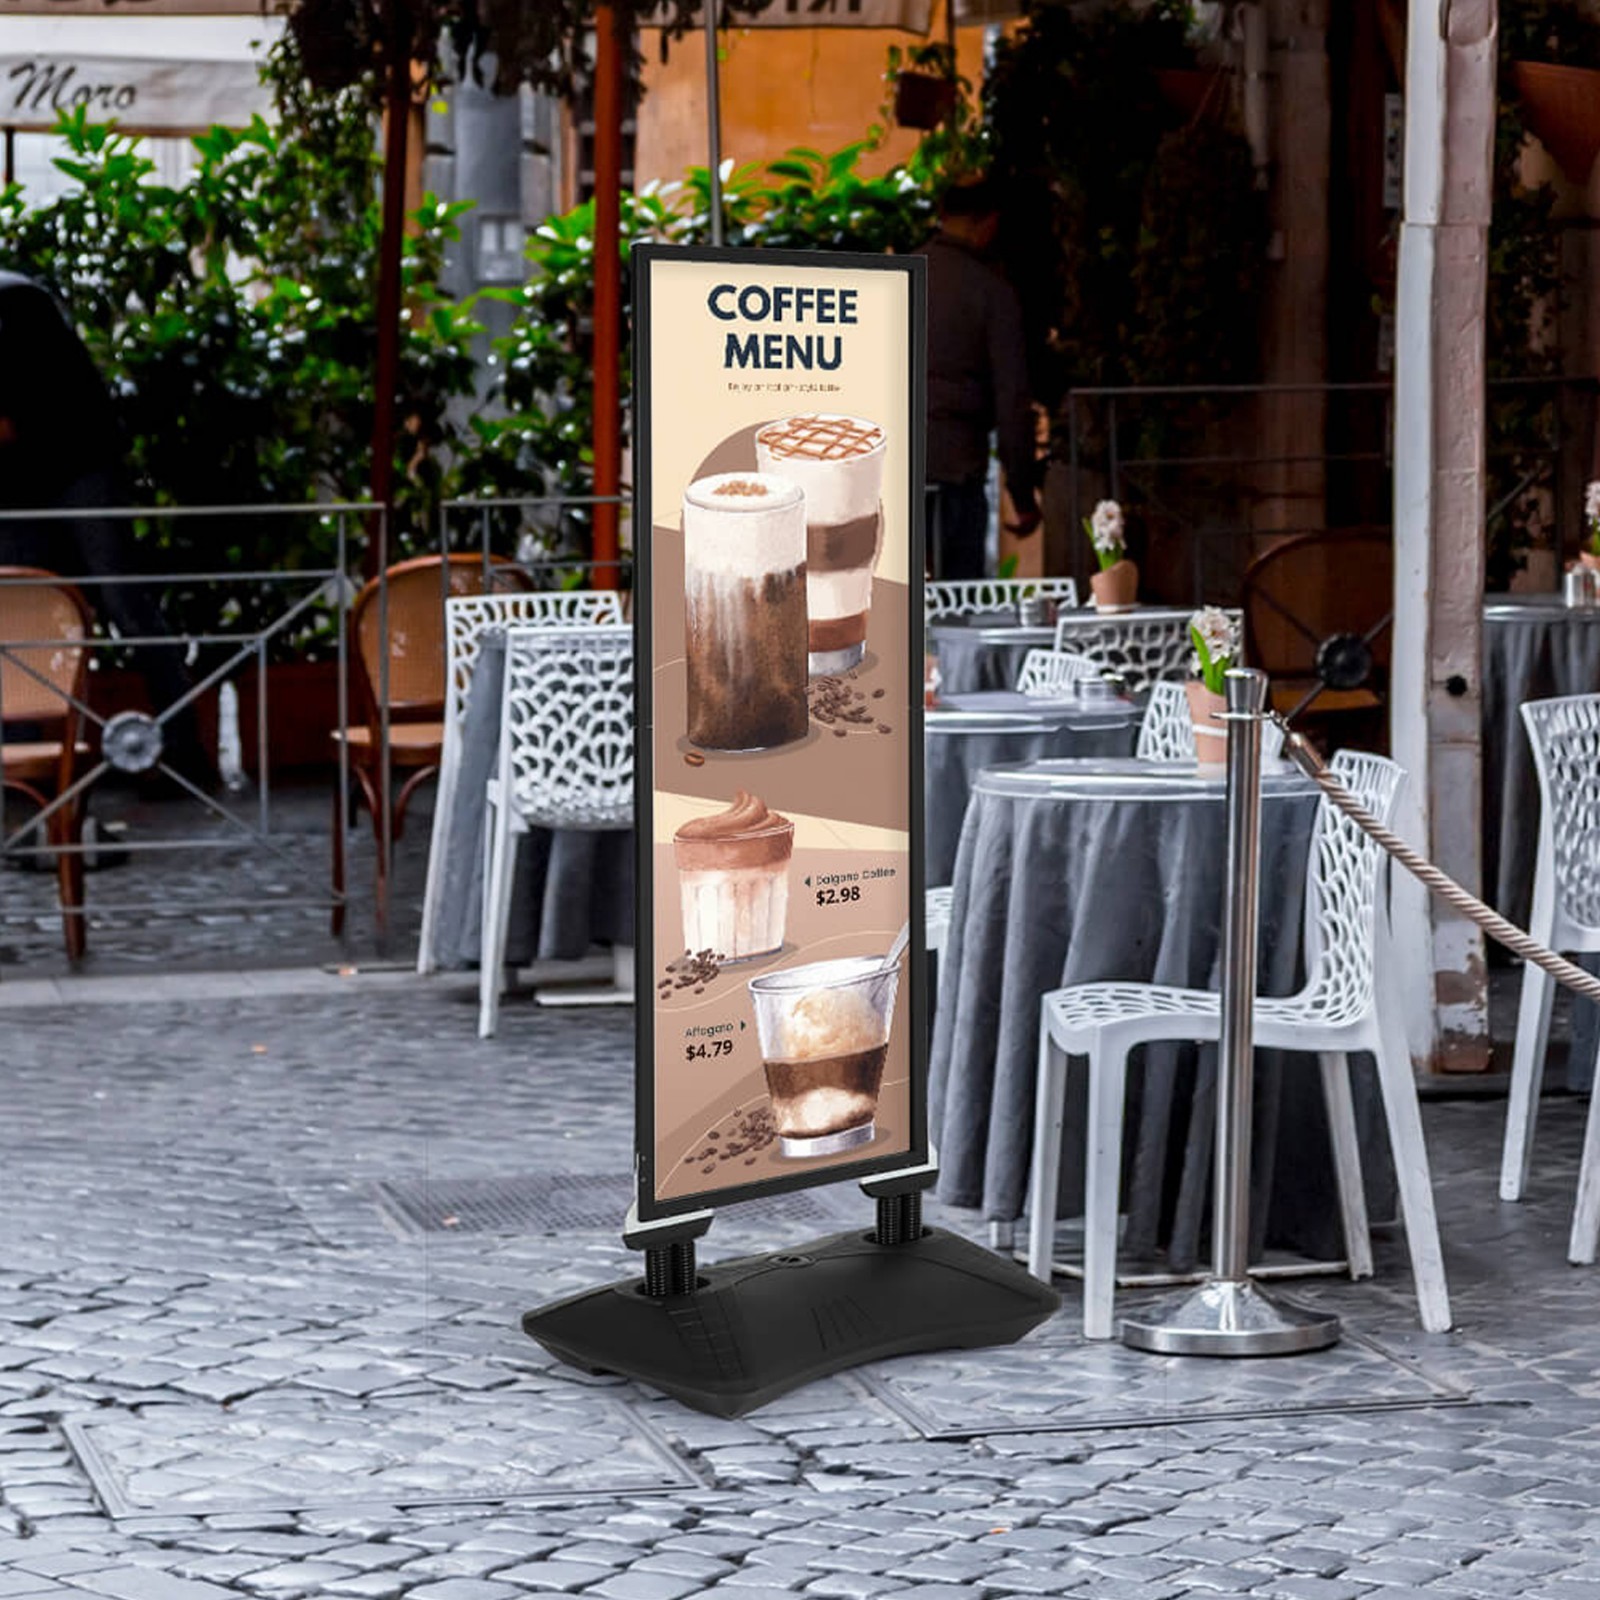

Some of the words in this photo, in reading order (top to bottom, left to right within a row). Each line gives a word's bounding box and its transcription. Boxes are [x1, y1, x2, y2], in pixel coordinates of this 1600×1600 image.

[9, 62, 137, 110] Moro
[708, 285, 858, 324] COFFEE
[725, 333, 842, 370] MENU
[816, 886, 860, 906] $2.98
[686, 1040, 733, 1061] $4.79
